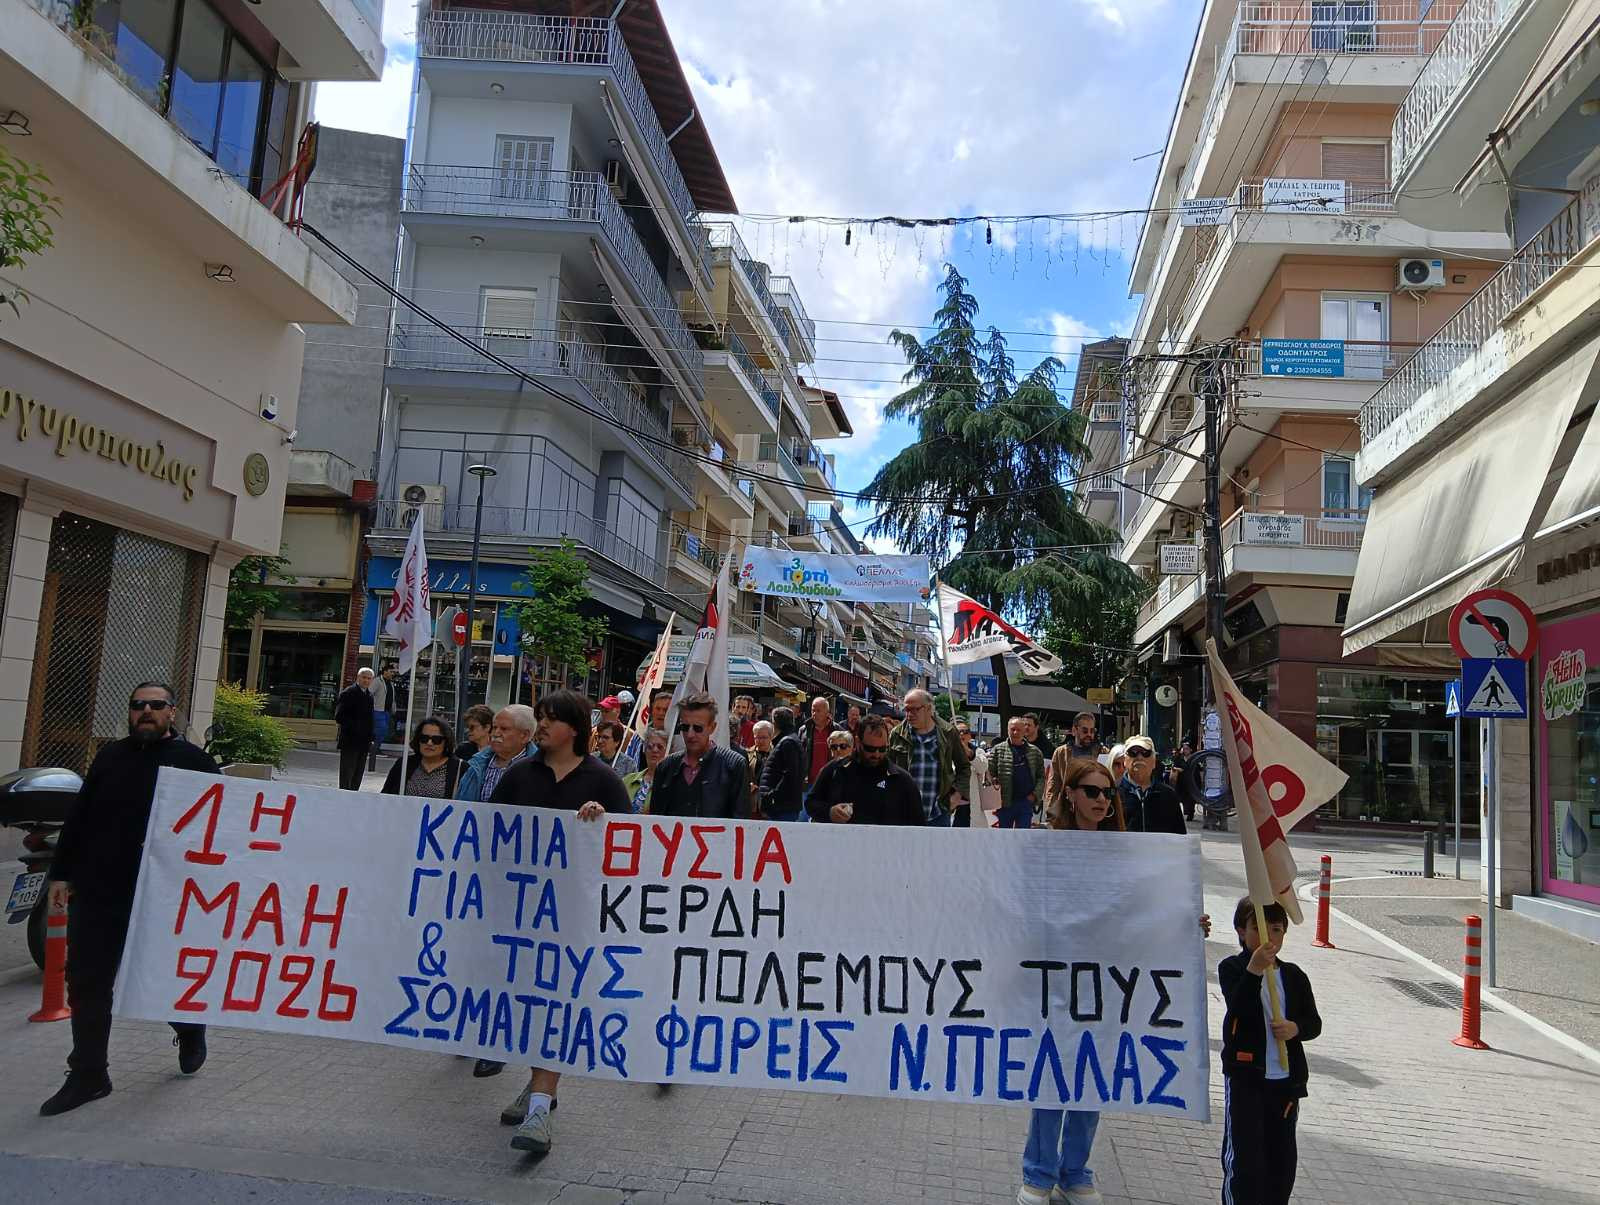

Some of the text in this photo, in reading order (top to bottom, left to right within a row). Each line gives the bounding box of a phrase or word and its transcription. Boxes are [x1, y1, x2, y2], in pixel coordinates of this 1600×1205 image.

[1278, 349, 1328, 357] ΟΔΟΝΤΙΑΤΡΟΣ
[416, 803, 792, 884] ΚΑΜΙΑ ΘΥΣΙΑ
[174, 877, 349, 950] ΜΑΗ
[407, 868, 786, 940] ΓΙΑ ΤΑ ΚΕΡΔΗ
[173, 947, 358, 1022] 2026
[417, 921, 1184, 1029] & ΤΟΥΣ ΠΟΛΕΜΟΥΣ ΤΟΥΣ
[655, 1005, 855, 1082] ΦΟΡΕΙΣ
